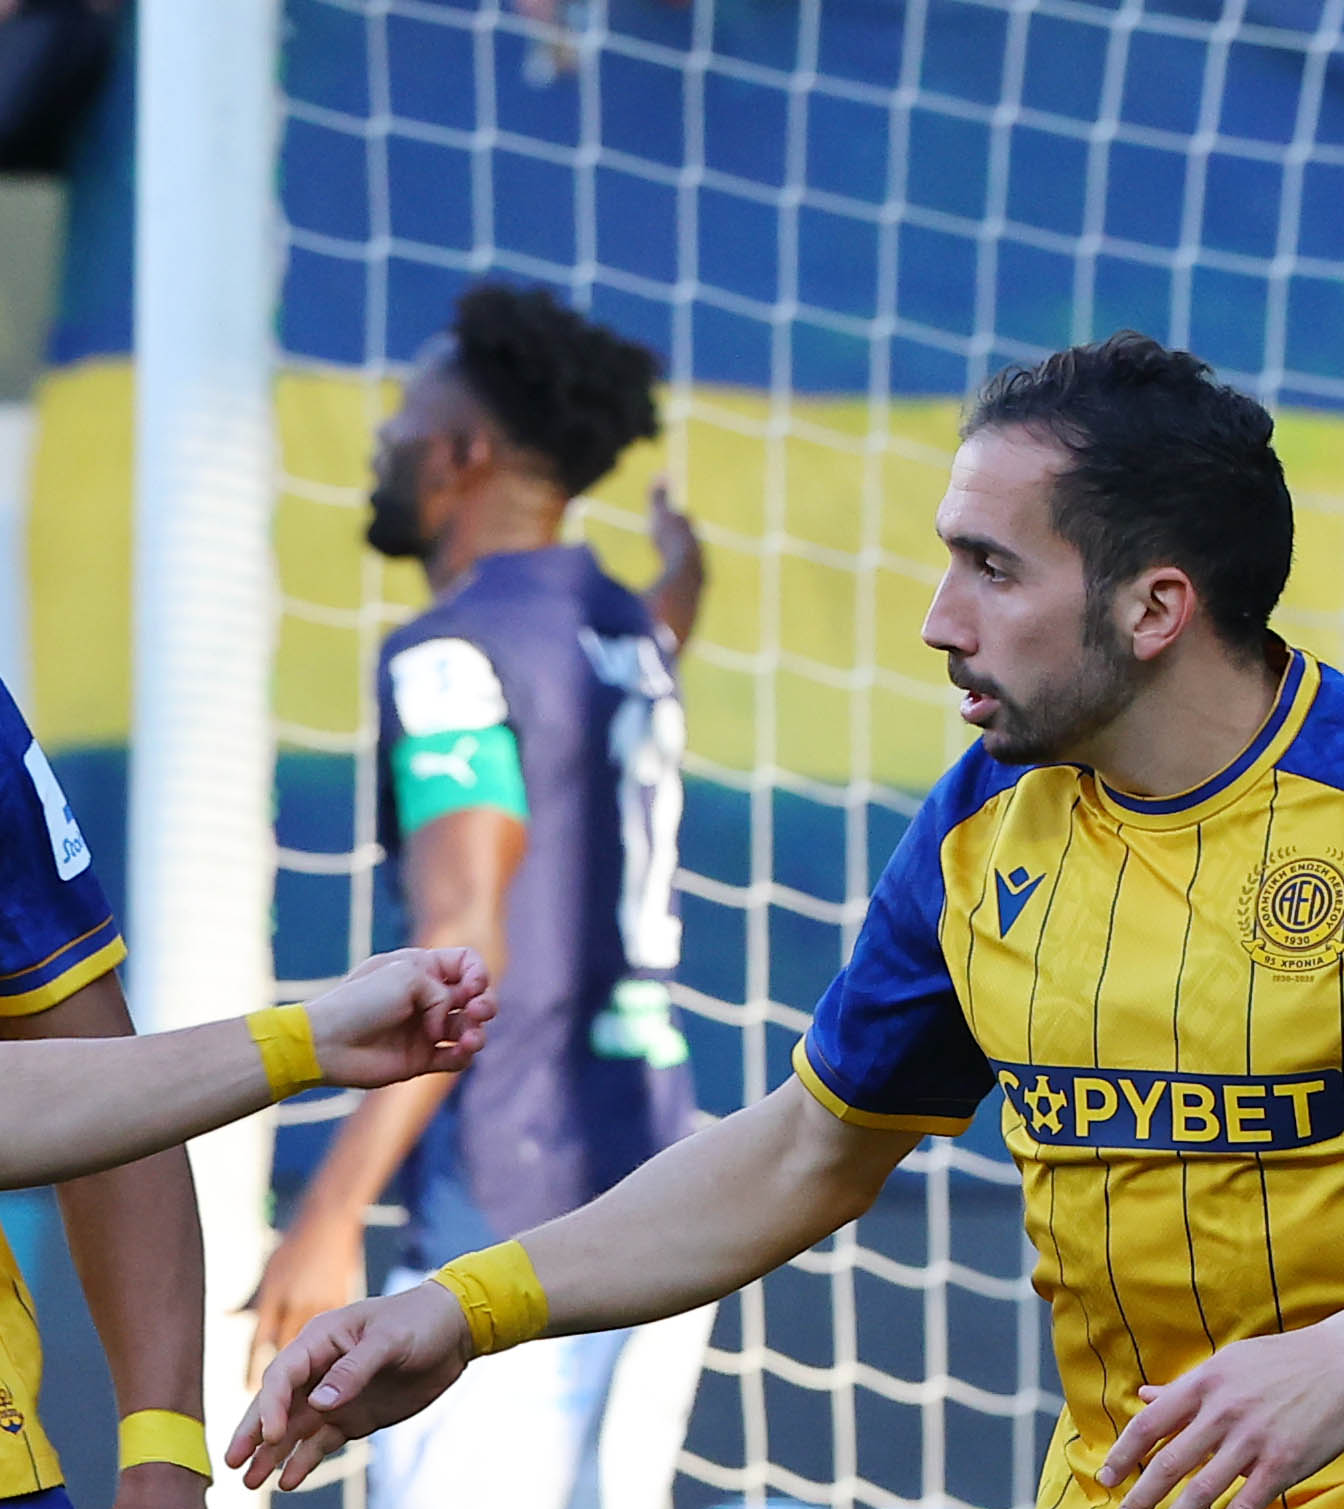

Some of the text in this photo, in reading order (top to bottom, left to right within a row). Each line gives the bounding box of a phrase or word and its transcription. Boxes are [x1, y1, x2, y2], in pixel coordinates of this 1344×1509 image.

[1284, 935, 1310, 945] 1930
[1264, 956, 1325, 969] 95 ΧΡΟΝΙΑ
